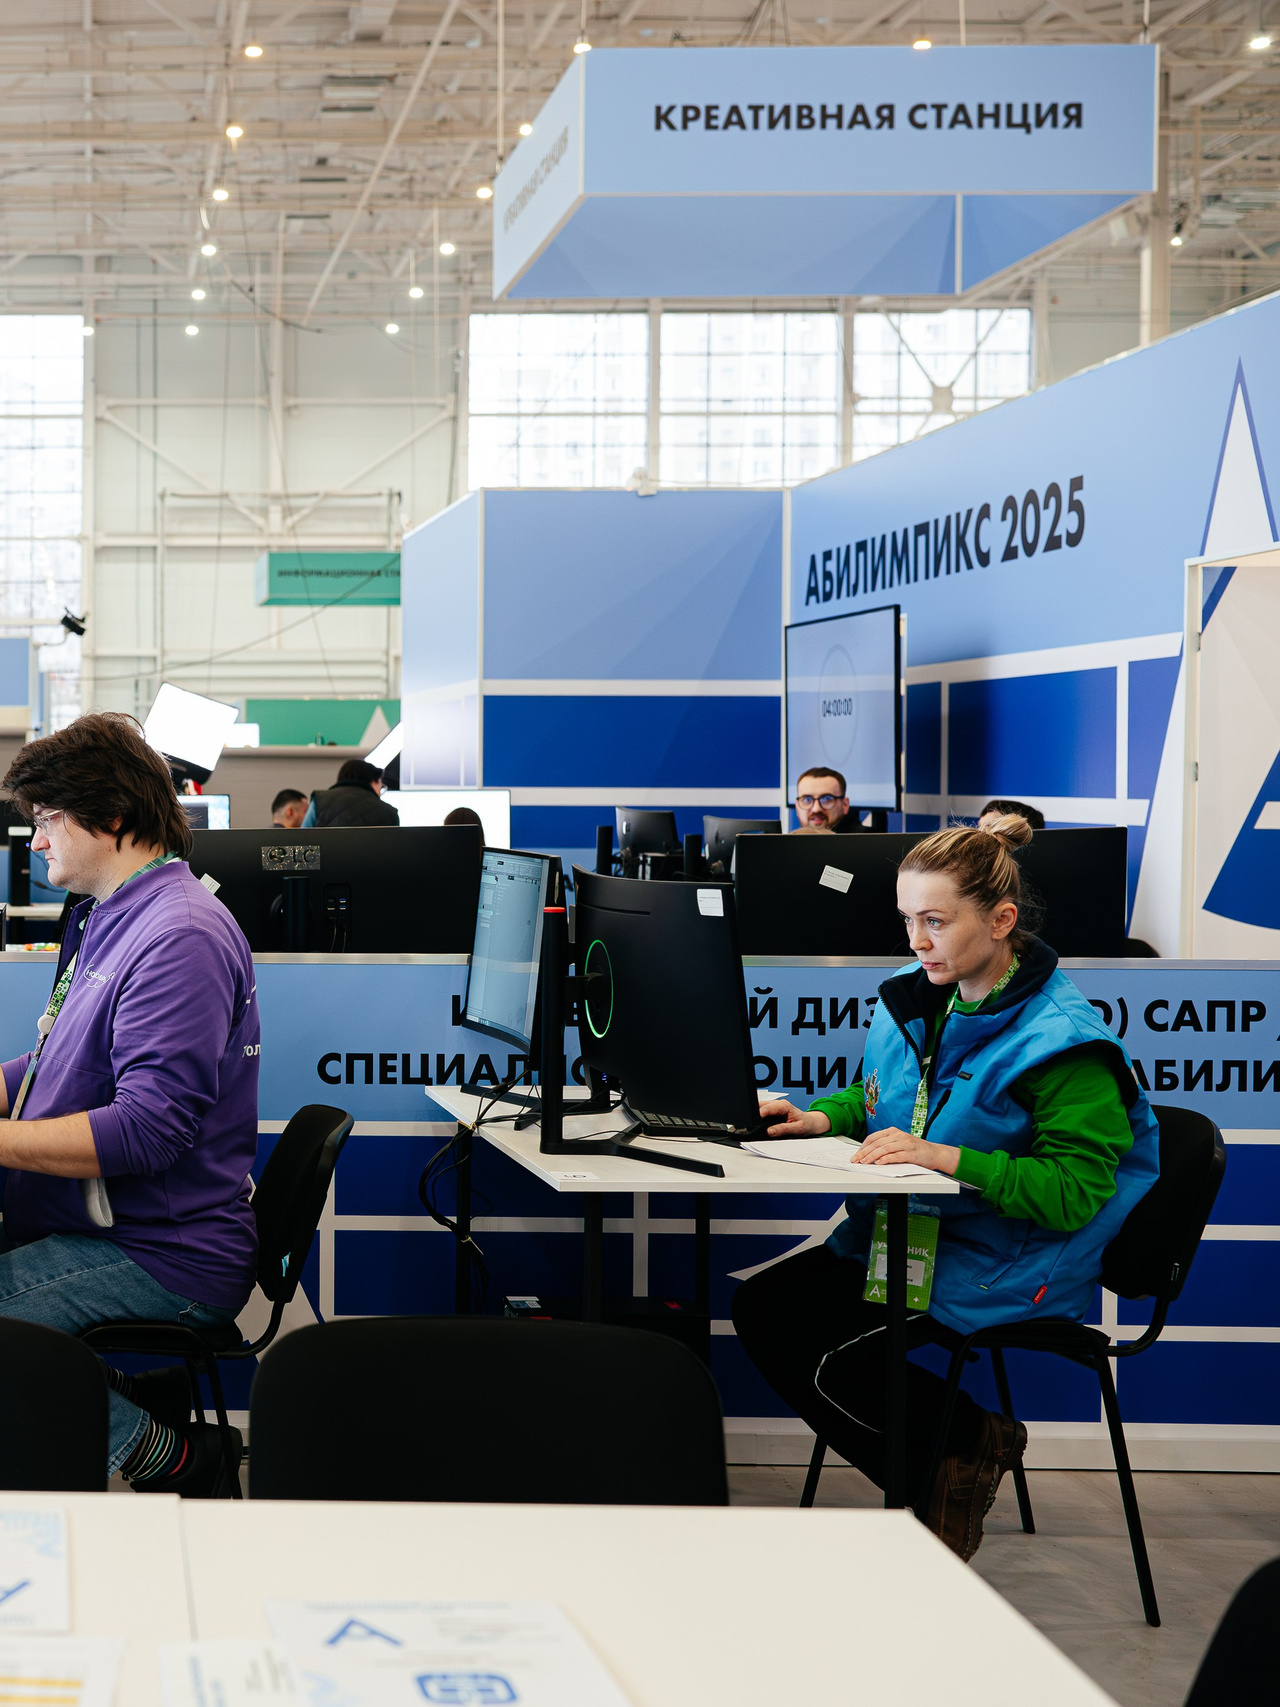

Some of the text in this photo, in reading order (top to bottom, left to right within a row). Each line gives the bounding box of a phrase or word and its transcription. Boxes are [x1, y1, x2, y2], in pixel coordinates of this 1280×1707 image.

[654, 102, 1084, 134] КРЕАТИВНАЯ СТАНЦИЯ
[805, 475, 1086, 606] АБИЛИМПИКС 2025
[822, 698, 853, 719] 04:00:00
[1143, 999, 1267, 1033] САПР
